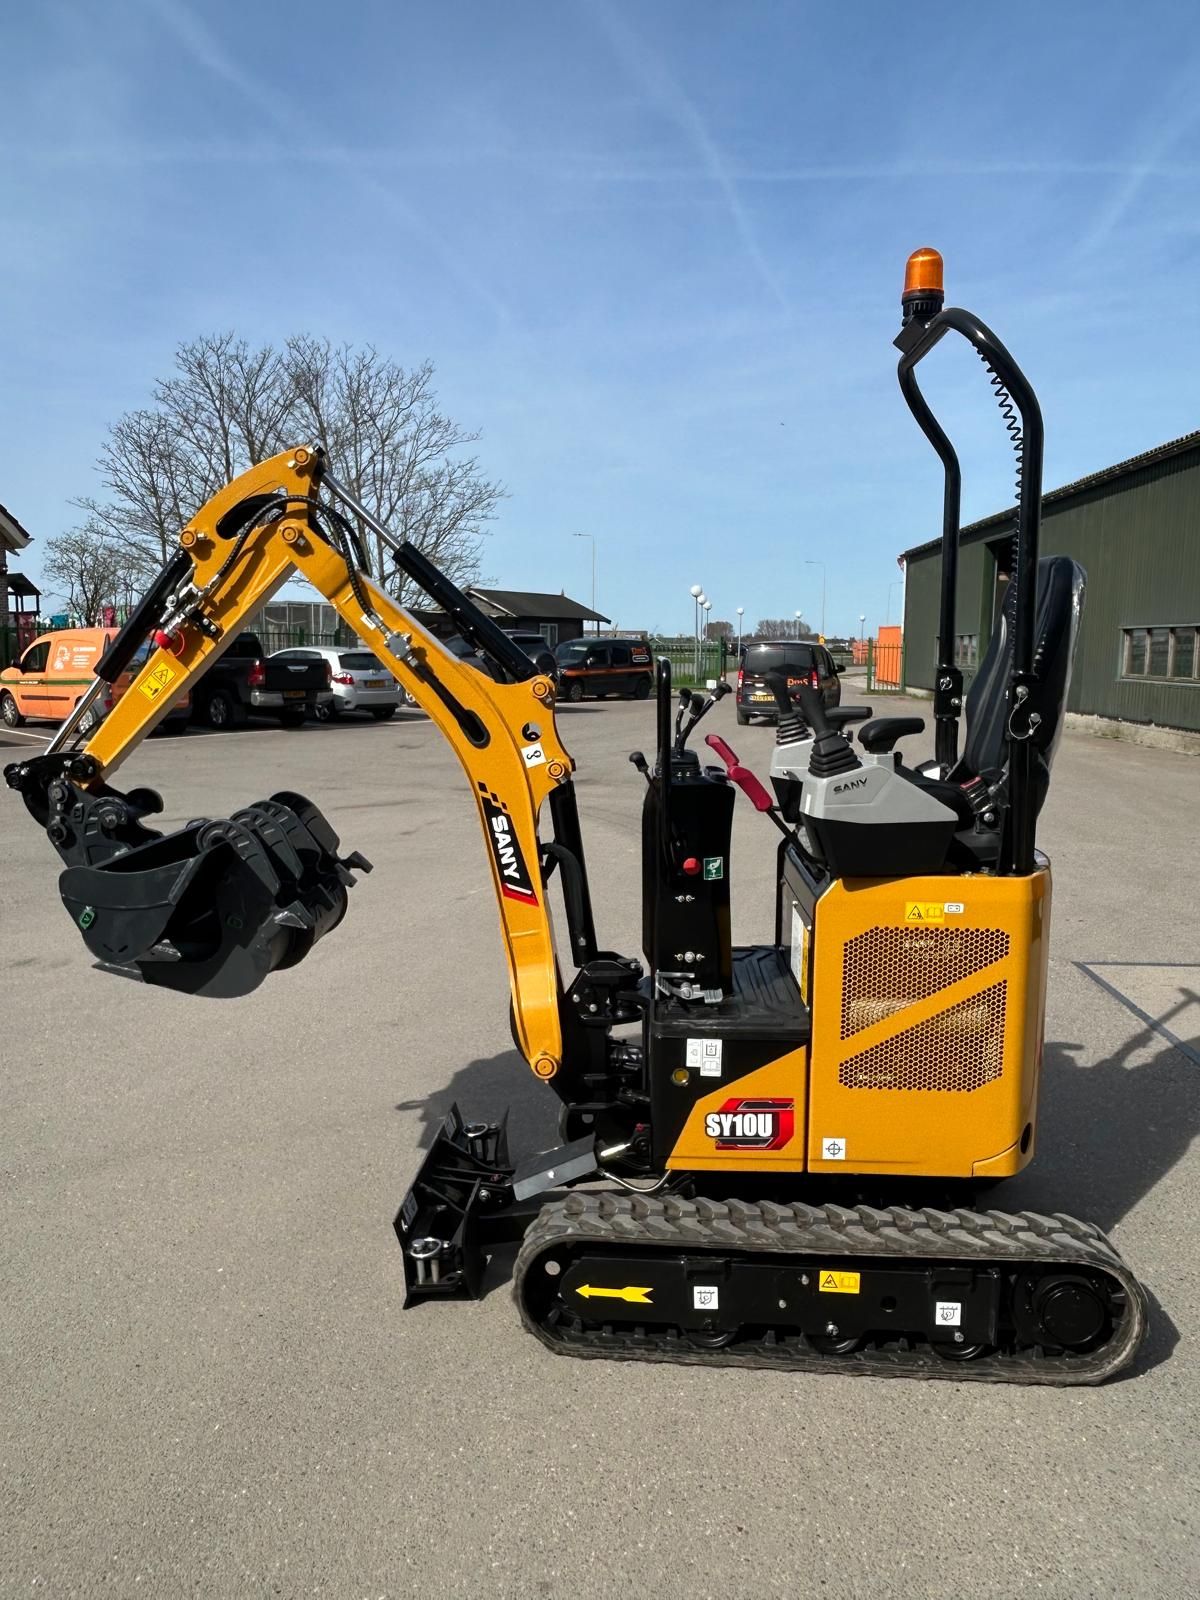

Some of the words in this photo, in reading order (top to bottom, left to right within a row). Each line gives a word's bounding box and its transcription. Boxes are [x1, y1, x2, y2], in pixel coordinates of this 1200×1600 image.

[833, 777, 868, 793] SANY
[491, 815, 520, 879] SANY
[706, 1113, 773, 1137] SY10U
